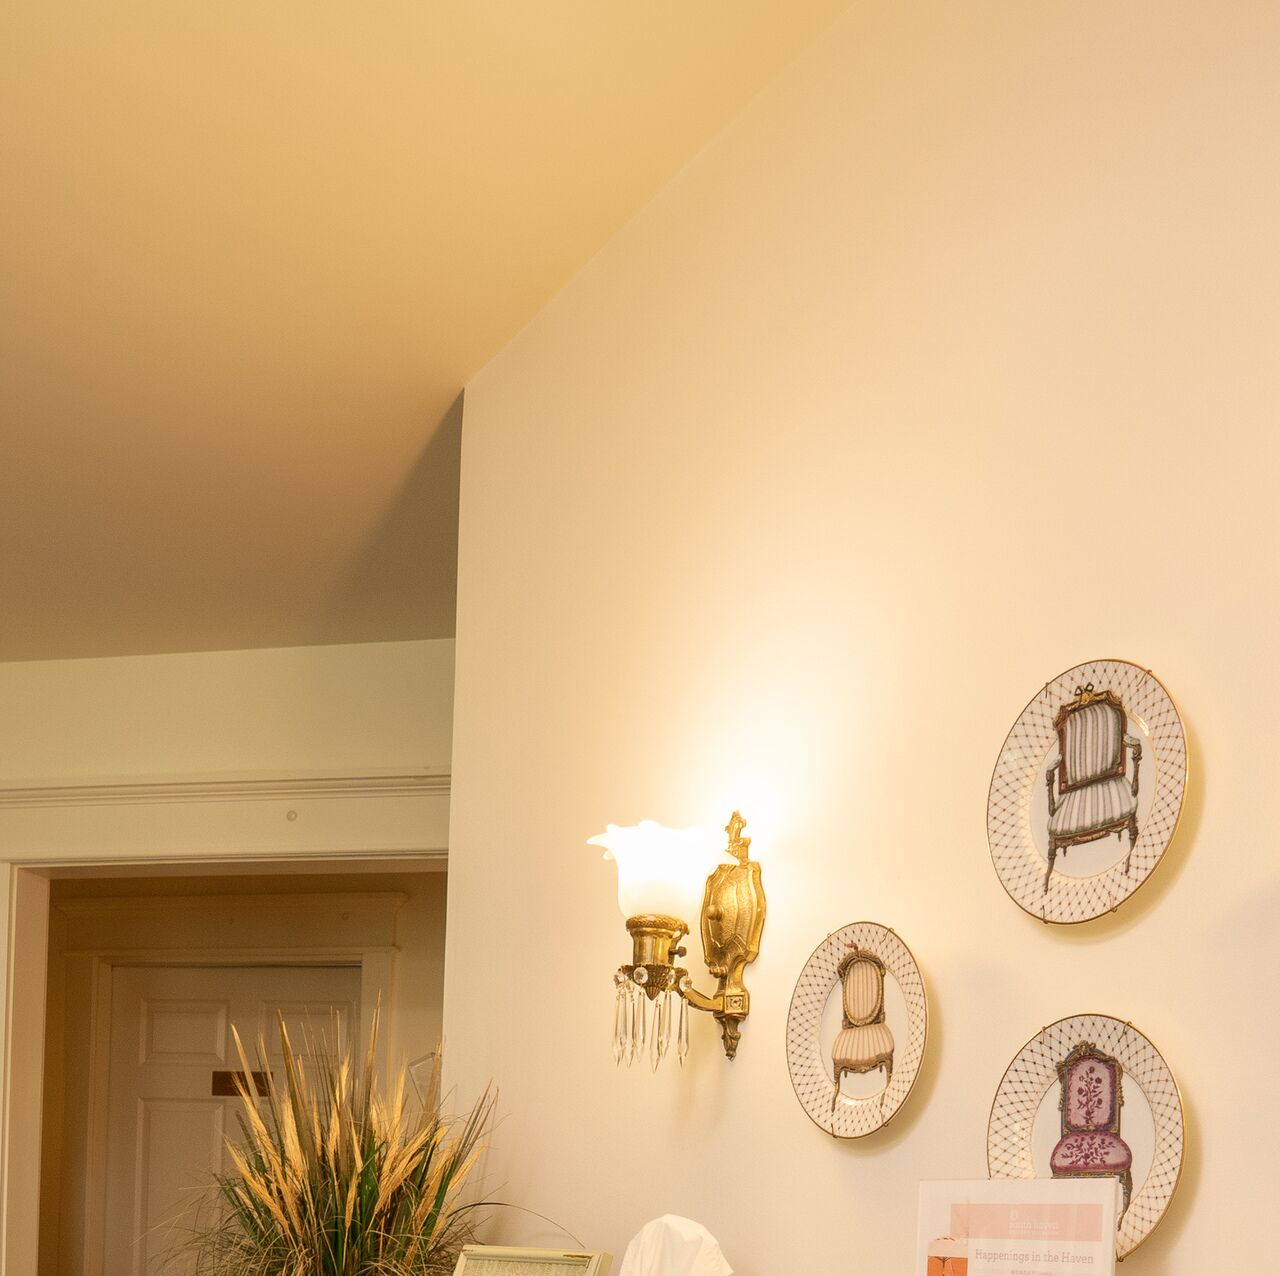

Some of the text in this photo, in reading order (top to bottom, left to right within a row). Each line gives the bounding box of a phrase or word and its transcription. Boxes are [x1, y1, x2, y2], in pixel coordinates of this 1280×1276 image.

[975, 1249, 1093, 1264] Happenings in the Haven
